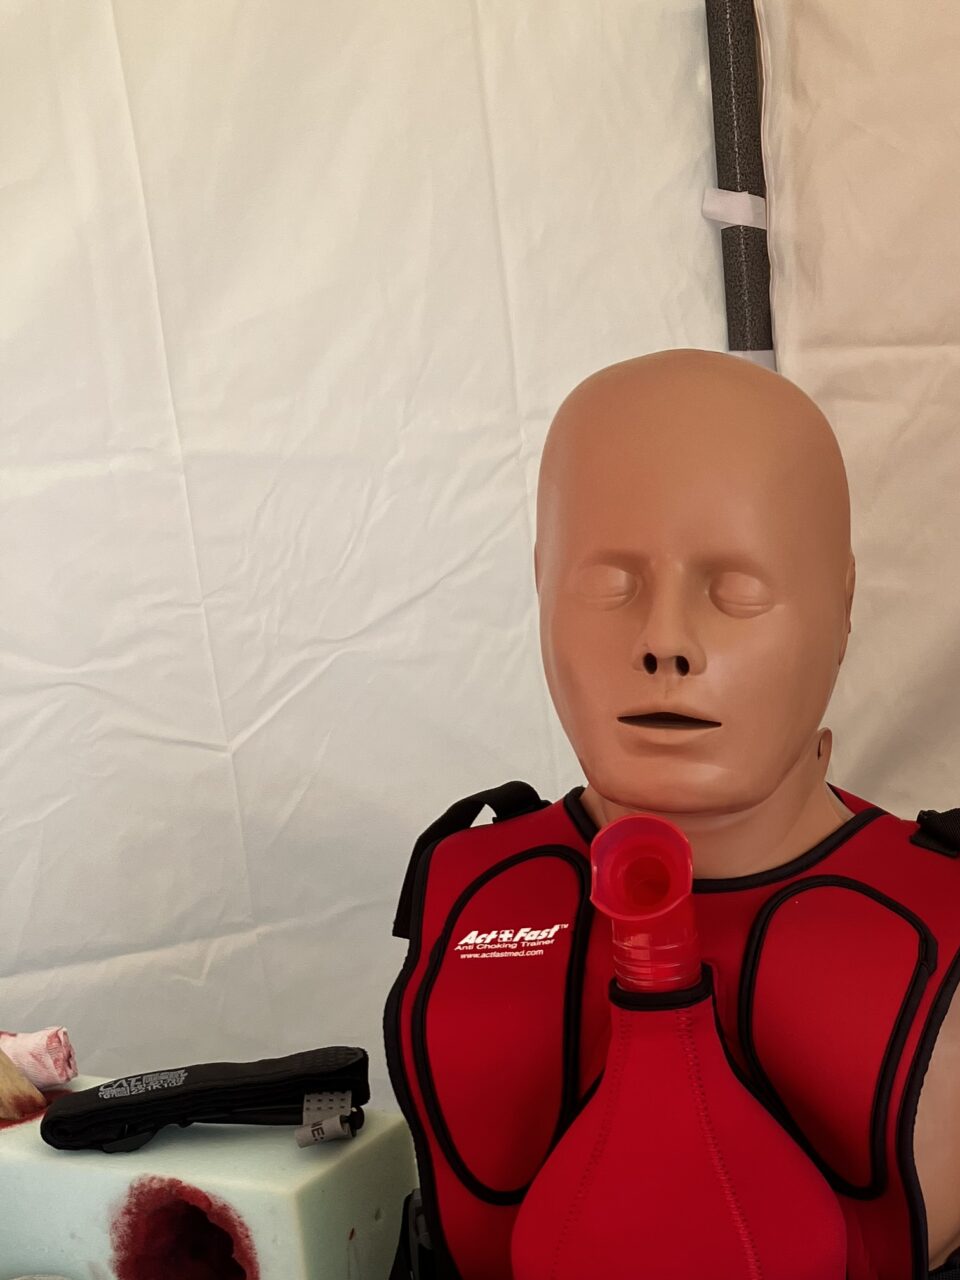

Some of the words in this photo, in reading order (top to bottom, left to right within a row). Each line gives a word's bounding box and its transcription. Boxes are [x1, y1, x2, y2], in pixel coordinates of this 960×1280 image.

[458, 930, 498, 945] Act
[454, 943, 474, 951] Anti
[476, 942, 518, 950] Choking
[521, 938, 556, 948] Trainer
[460, 949, 544, 959] www.actfastmed.com
